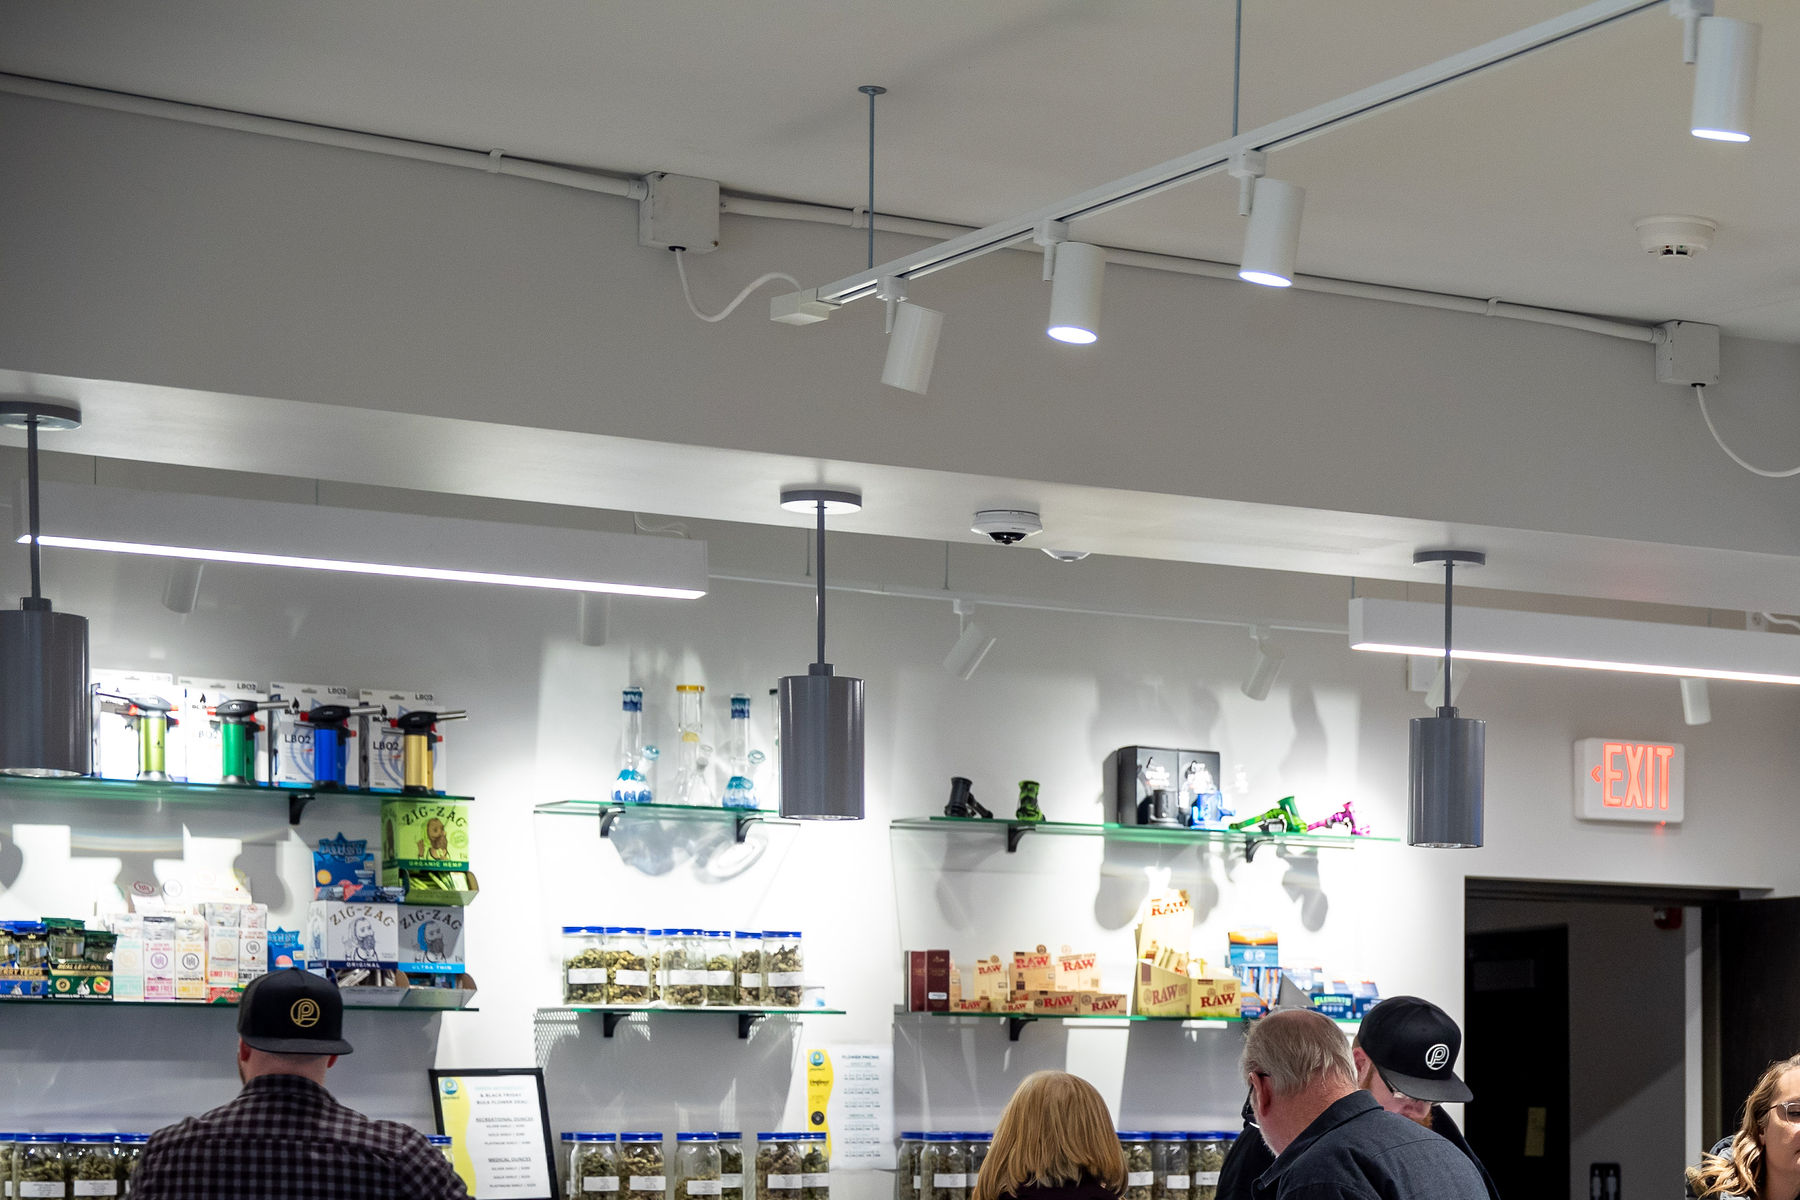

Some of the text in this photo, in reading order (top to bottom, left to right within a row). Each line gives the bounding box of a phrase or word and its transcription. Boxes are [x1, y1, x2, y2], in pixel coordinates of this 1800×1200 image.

[1604, 742, 1674, 809] EXIT
[402, 805, 467, 827] ZIG-ZAG
[330, 906, 395, 927] ZIG-ZAG
[400, 909, 462, 931] ZIG-ZAG
[346, 961, 380, 969] ORIGINAL
[1016, 956, 1049, 969] RAW
[1063, 959, 1096, 972] RAW
[978, 964, 1002, 975] RAW
[1043, 995, 1074, 1008] RAW
[1152, 984, 1177, 1006] RAW
[1200, 992, 1235, 1008] RAW
[961, 1001, 981, 1010] RAW
[1008, 1003, 1028, 1011] RAW
[1092, 1000, 1119, 1011] RAW
